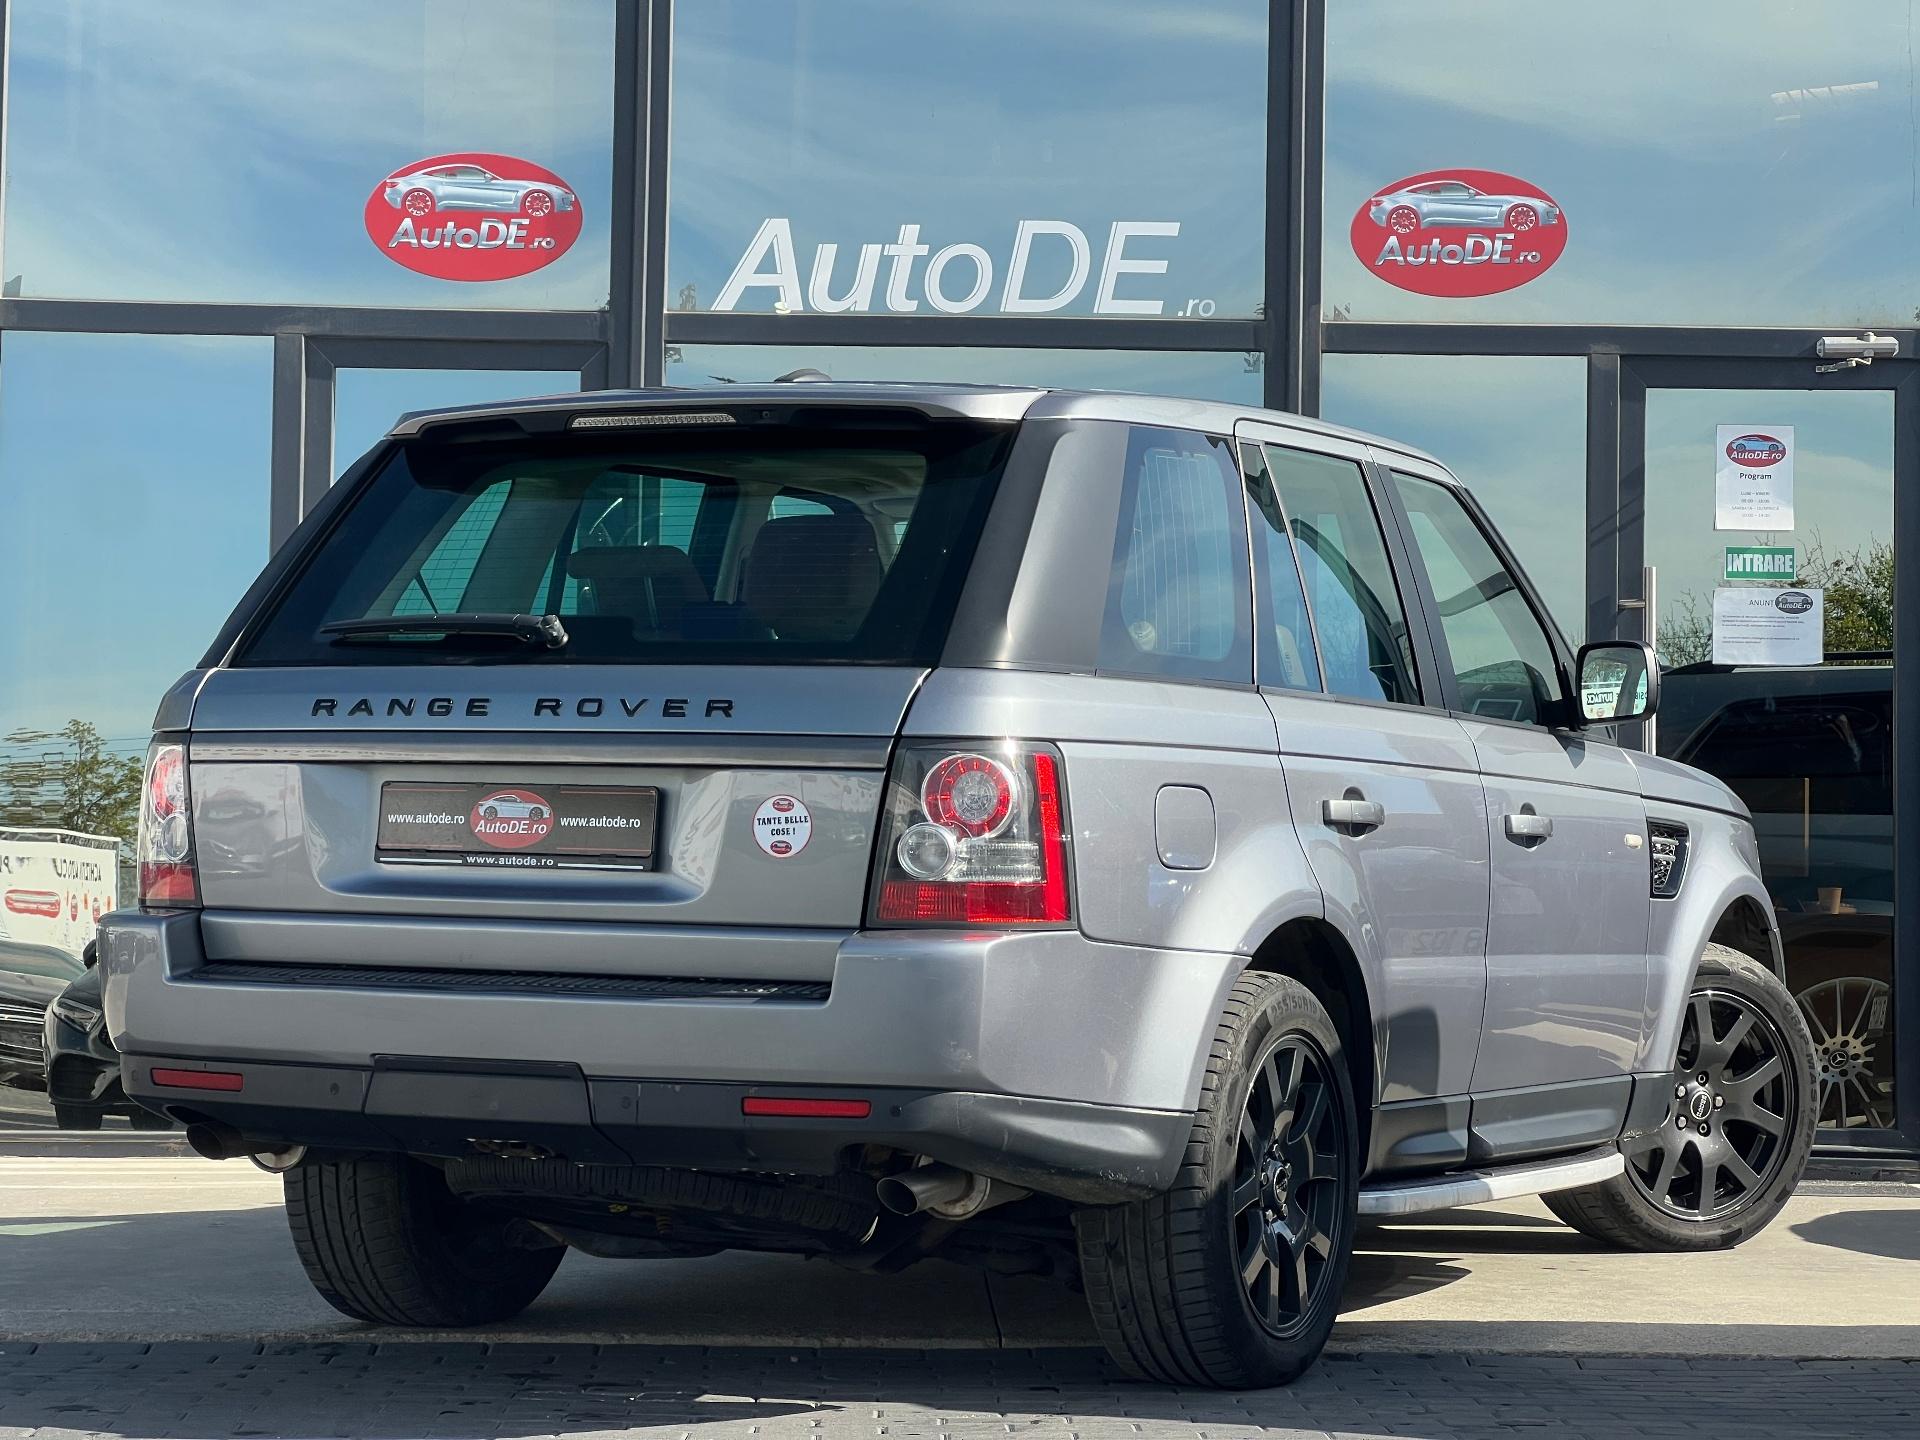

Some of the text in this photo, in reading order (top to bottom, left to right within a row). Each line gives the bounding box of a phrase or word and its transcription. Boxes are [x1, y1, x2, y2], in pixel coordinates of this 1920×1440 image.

[1739, 472, 1772, 480] Program
[1727, 553, 1793, 573] INTRARE
[311, 698, 734, 718] RANGE ROVER
[387, 812, 641, 835] www.autode.ro AutoDE.ro www.autode.ro
[757, 815, 809, 826] TANTE BELLE
[770, 828, 791, 836] COSE
[466, 855, 554, 867] www.autode.ro
